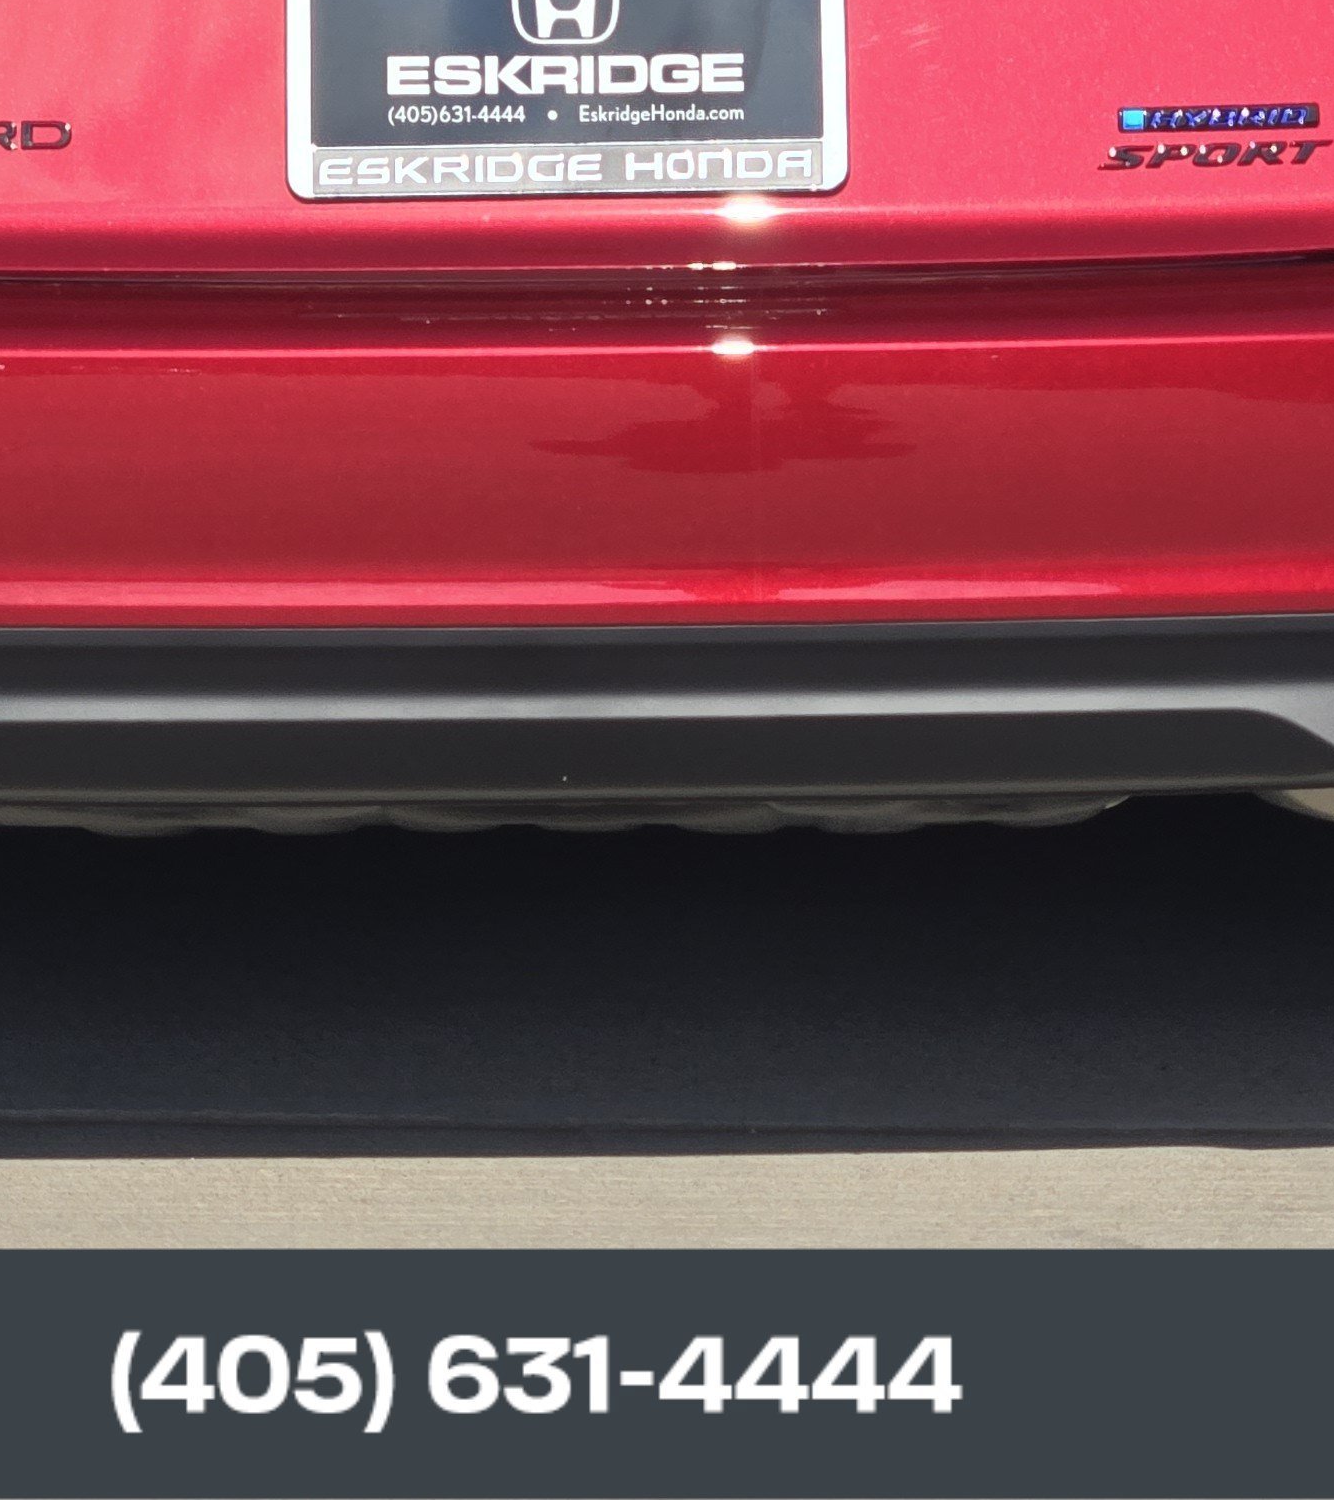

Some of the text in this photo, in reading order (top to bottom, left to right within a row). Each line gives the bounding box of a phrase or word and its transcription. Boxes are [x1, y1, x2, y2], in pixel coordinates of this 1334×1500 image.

[386, 53, 745, 96] ESKRIDGE
[387, 103, 745, 126] (405)631-4444 EskridgeHonda.com
[318, 147, 815, 188] ESKRIDGE HONDA
[1097, 139, 1334, 171] SPORT
